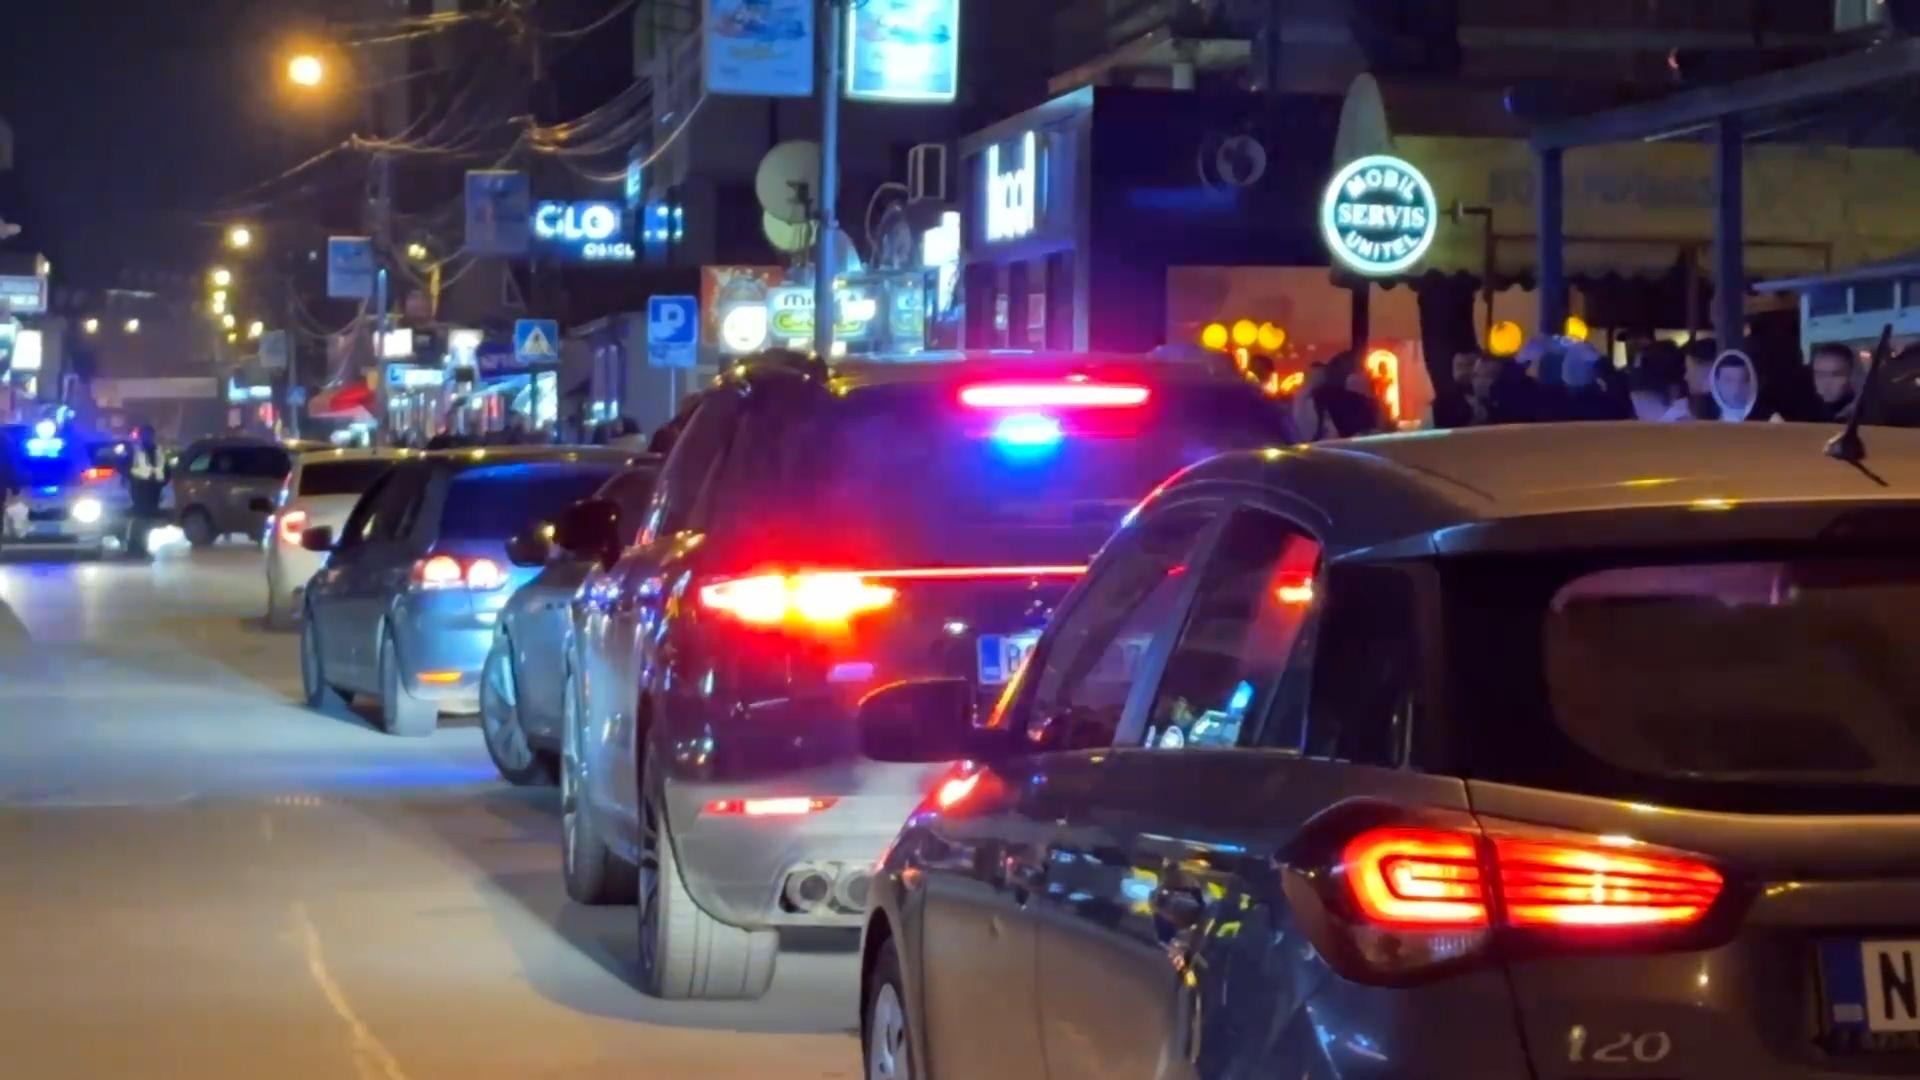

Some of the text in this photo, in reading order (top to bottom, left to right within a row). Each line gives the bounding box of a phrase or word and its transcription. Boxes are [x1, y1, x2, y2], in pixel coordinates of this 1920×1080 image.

[1346, 167, 1415, 203] MOBIL
[1338, 202, 1426, 230] SERVIS
[1345, 230, 1419, 261] UNITEL
